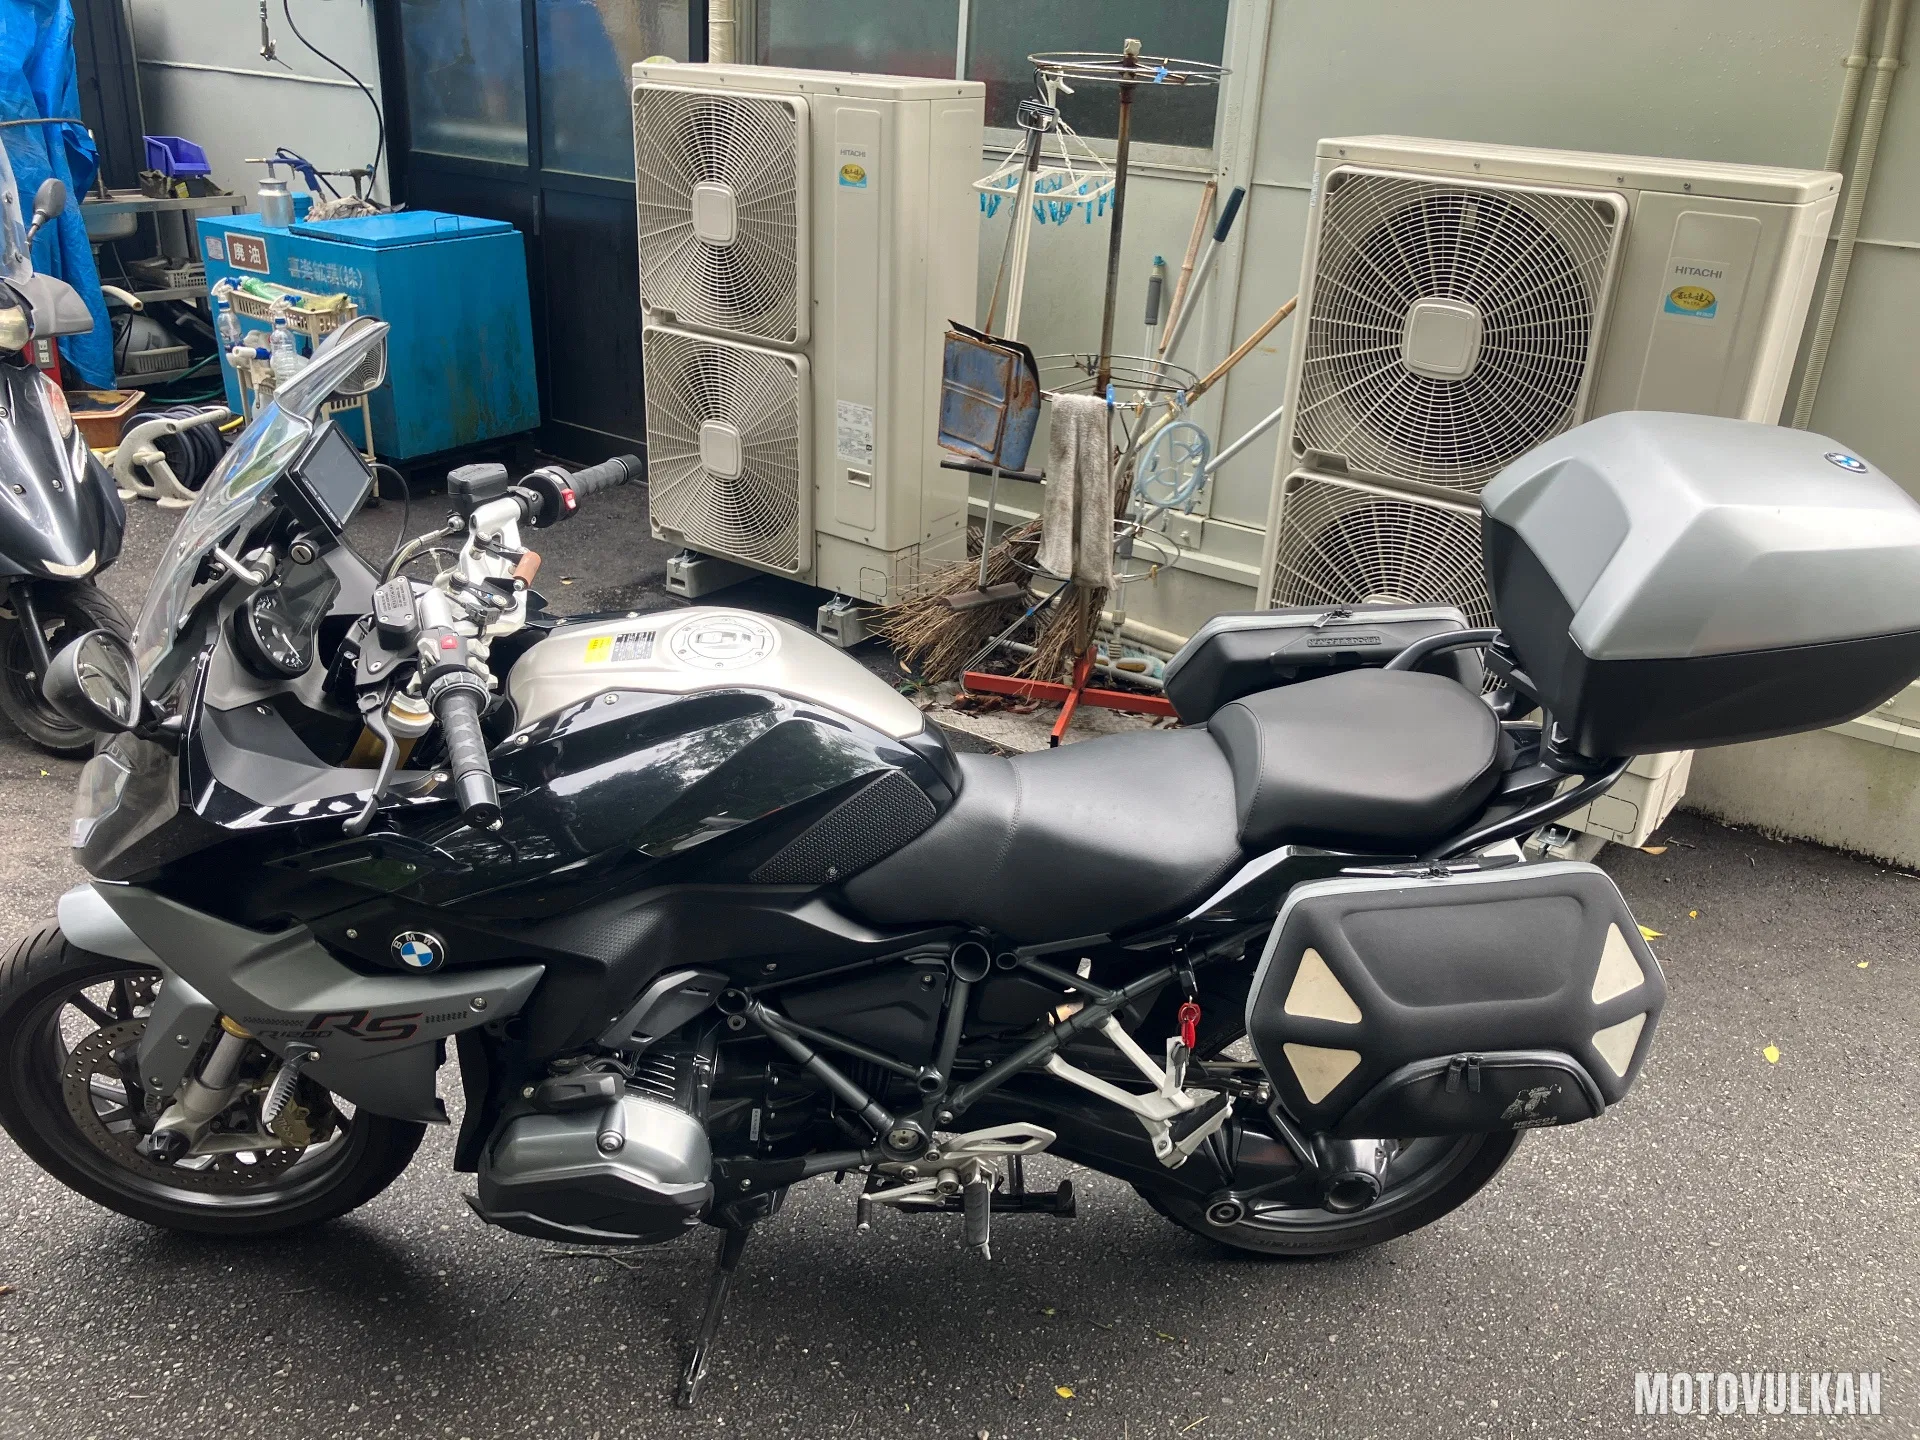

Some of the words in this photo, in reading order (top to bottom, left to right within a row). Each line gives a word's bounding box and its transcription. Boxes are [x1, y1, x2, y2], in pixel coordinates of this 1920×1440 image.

[840, 149, 867, 158] HITACHI
[233, 242, 262, 265] 廃油
[1675, 265, 1723, 279] HITACHI
[392, 933, 434, 950] BMW
[306, 1010, 424, 1042] RS
